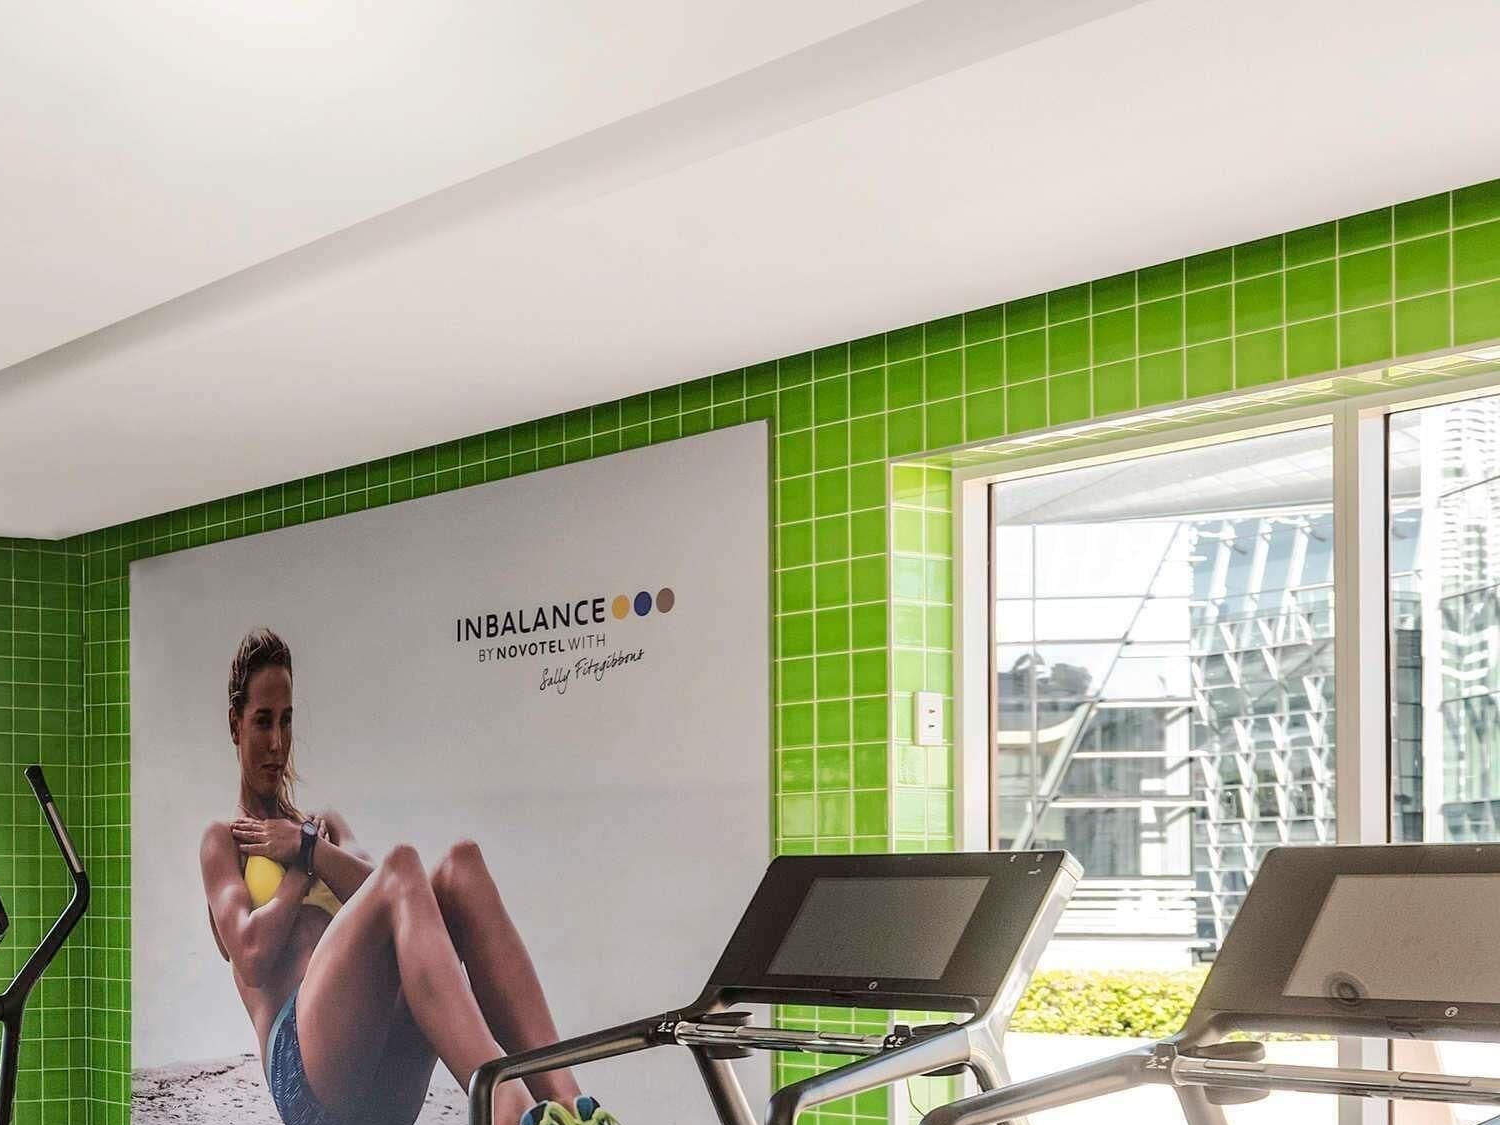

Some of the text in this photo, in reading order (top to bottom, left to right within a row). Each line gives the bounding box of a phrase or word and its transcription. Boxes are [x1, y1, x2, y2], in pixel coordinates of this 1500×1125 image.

[456, 598, 606, 642] INBALANCE
[478, 633, 606, 663] BY NOVOTEL WITH
[539, 668, 571, 695] Sally
